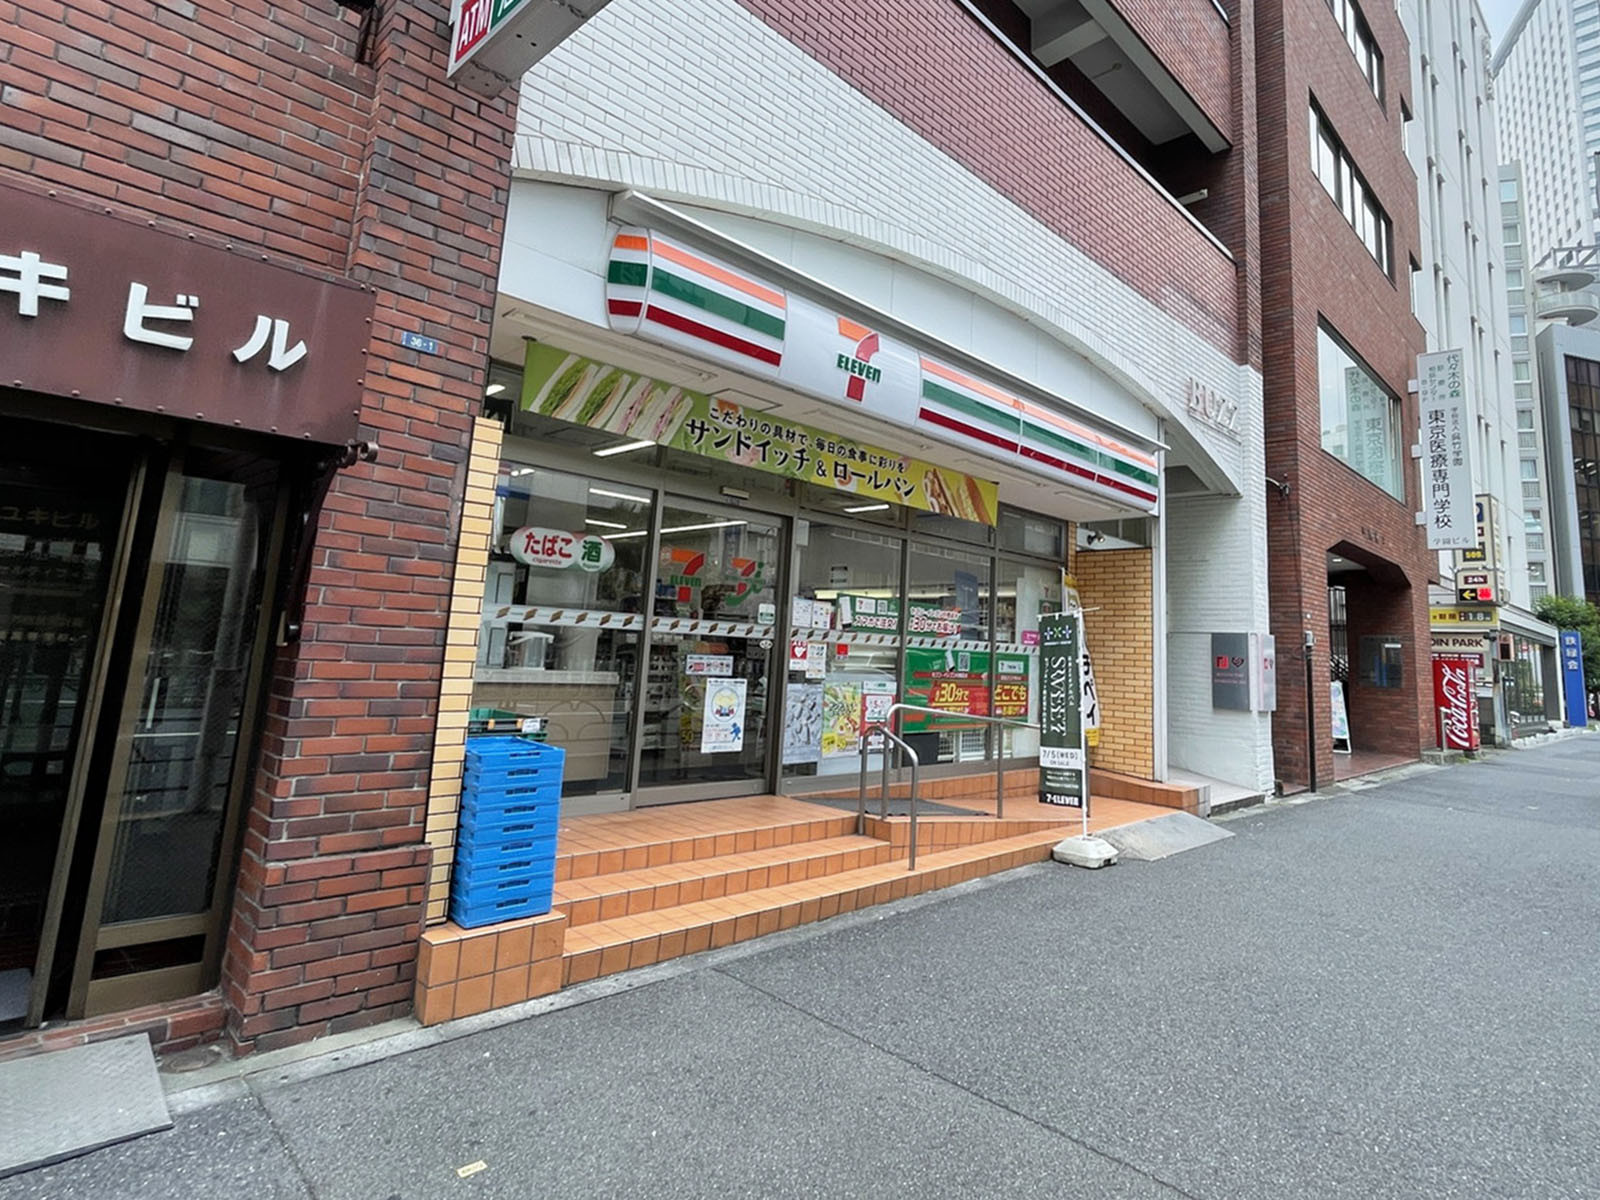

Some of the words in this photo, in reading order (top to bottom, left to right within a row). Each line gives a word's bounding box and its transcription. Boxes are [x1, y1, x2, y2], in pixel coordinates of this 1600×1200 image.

[458, 0, 492, 51] ATM
[0, 250, 307, 371] キビル
[410, 336, 434, 351] 36-1
[1447, 353, 1461, 398] 代々木の森
[686, 418, 811, 472] サンドイッチ
[816, 460, 827, 478] &
[833, 460, 916, 497] ロールパン
[709, 407, 905, 474] こだわりの具材で、毎日の食事に彩りを
[1428, 409, 1452, 529] 東京医療専門学校
[524, 531, 573, 559] たばこ
[581, 540, 602, 563] 酒
[1452, 639, 1483, 648] PARK
[994, 685, 1026, 701] どこでも
